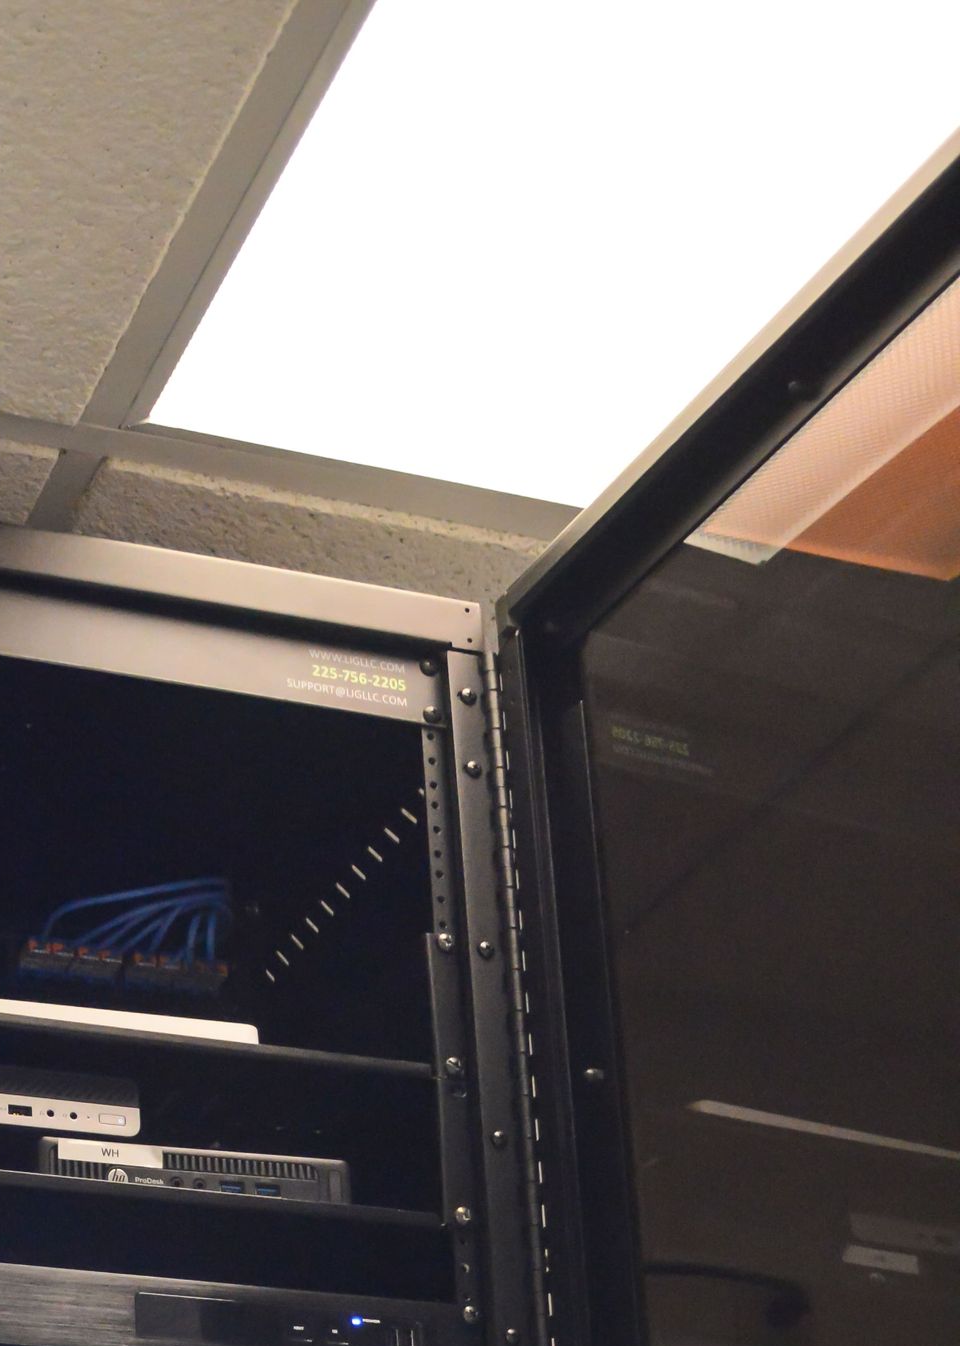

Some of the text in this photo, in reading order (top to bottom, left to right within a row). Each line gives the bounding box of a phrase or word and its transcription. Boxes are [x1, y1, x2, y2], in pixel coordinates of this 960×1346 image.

[311, 664, 407, 692] 225-756-2205
[286, 678, 408, 707] SUPPORT@LIGLLC.COM
[101, 1148, 120, 1158] WH
[134, 1176, 164, 1185] ProDesk
